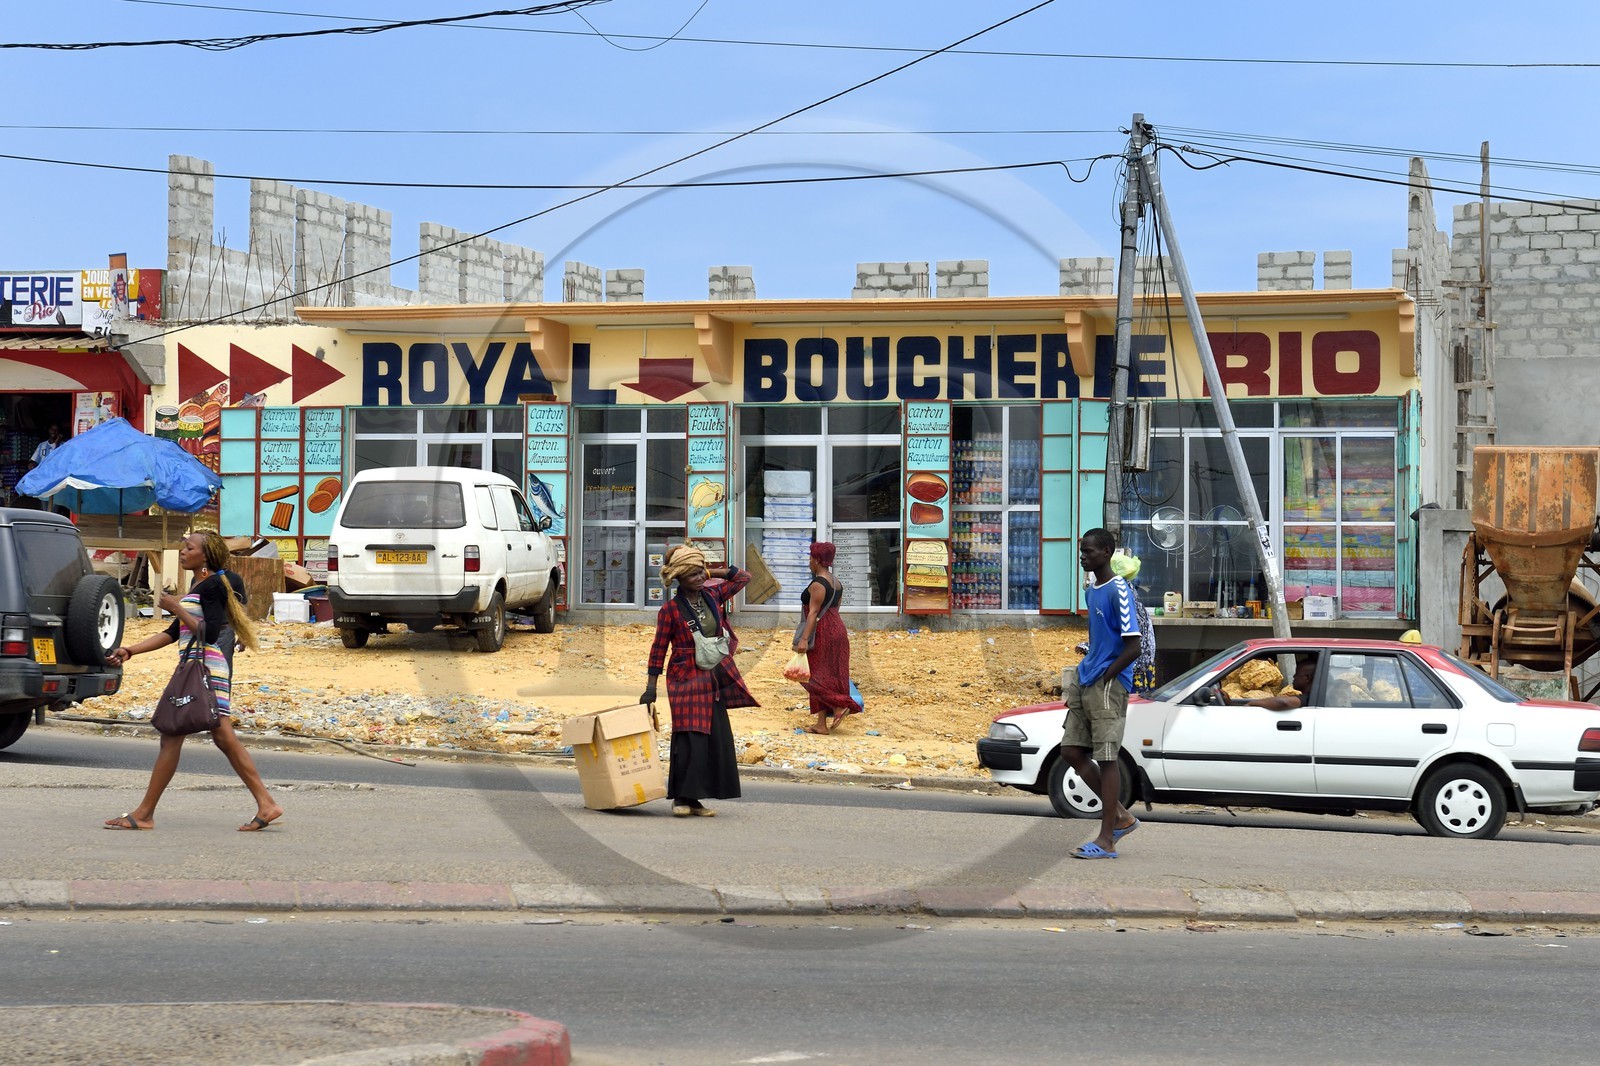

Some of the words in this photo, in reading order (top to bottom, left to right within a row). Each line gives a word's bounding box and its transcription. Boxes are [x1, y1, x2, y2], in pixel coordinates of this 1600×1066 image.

[83, 286, 94, 298] EN
[362, 342, 617, 406] ROYAL
[743, 333, 1167, 403] BOUCHERIE
[1202, 330, 1381, 397] RIO
[691, 418, 725, 431] Poulets
[382, 553, 421, 562] AL-123-AA
